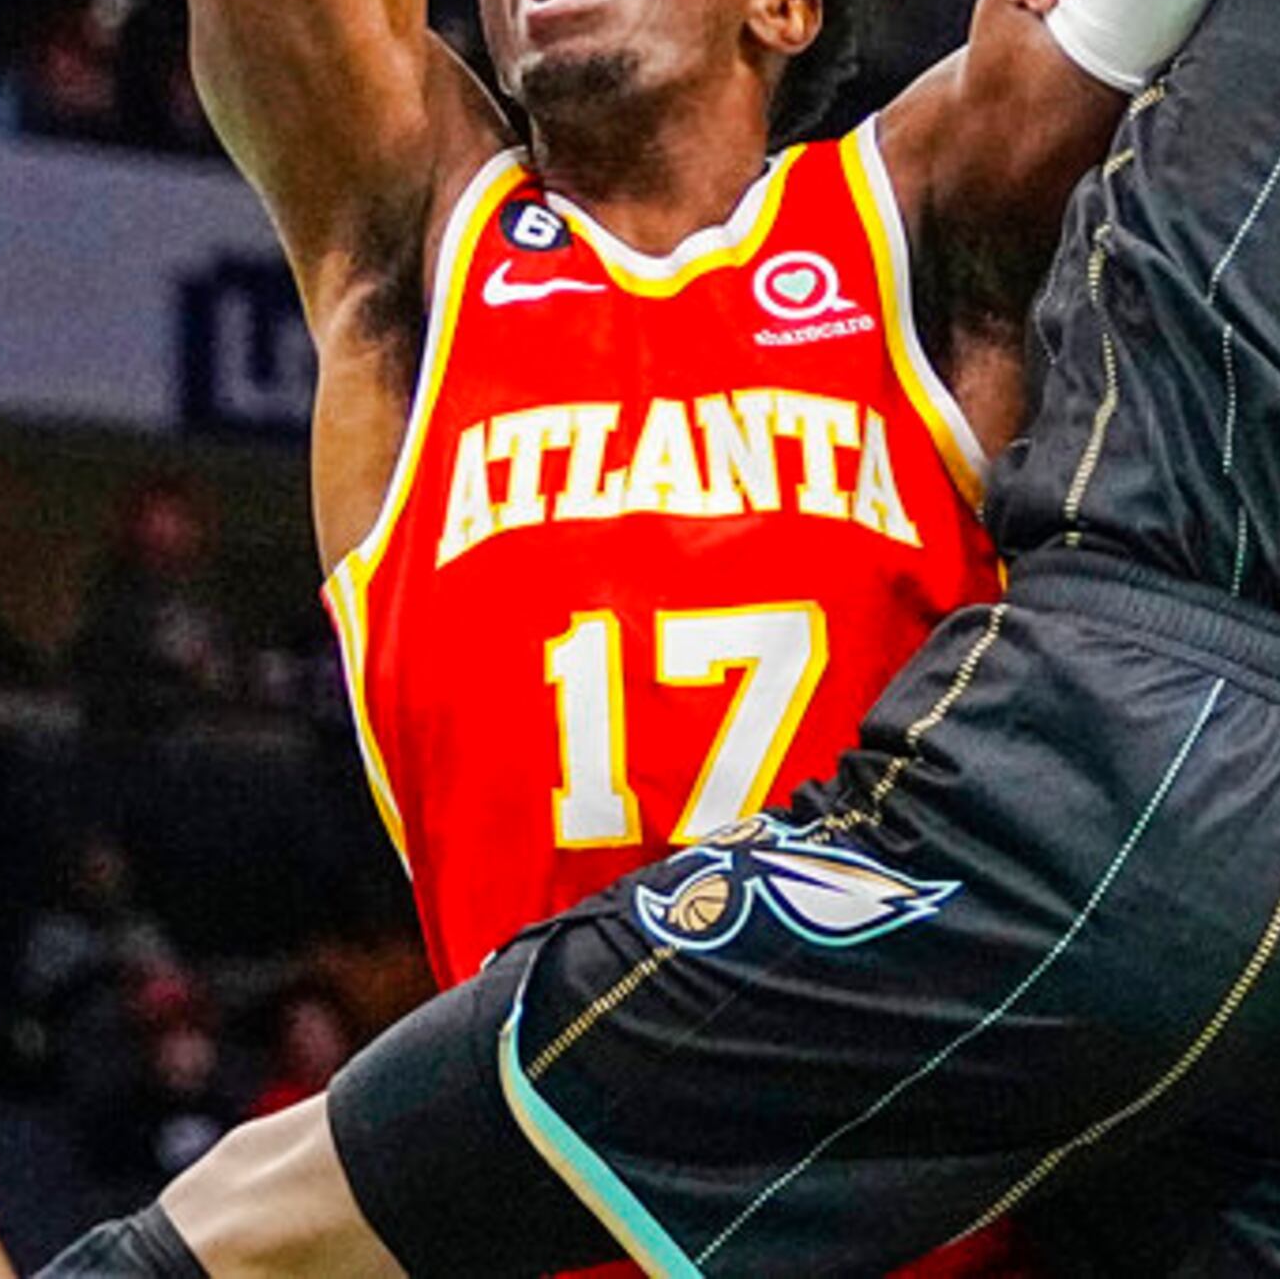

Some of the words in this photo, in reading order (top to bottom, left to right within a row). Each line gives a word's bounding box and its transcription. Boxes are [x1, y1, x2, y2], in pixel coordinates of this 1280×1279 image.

[513, 206, 562, 247] 6
[753, 315, 875, 346] sharecare
[436, 388, 923, 570] ATLANTA
[544, 601, 828, 849] 17
